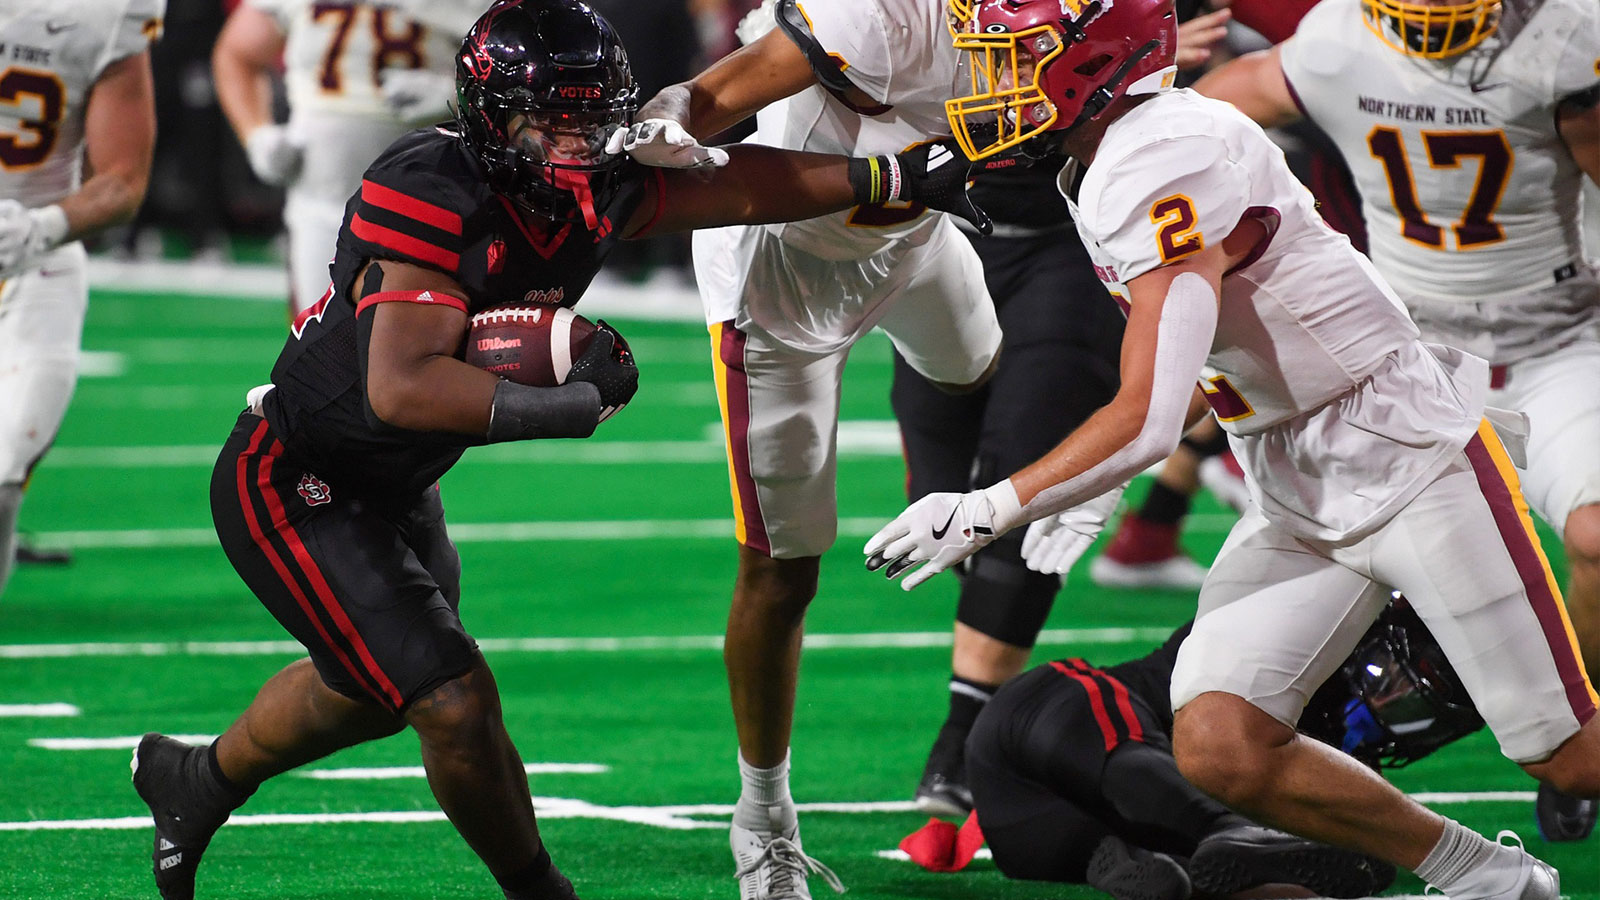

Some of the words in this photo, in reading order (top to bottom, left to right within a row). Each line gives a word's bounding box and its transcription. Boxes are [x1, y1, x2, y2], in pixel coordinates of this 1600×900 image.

[310, 1, 425, 98] 78
[559, 86, 601, 98] YOTES
[1358, 94, 1436, 122] NORTHERN
[1445, 106, 1492, 126] STATE
[892, 161, 901, 179] TEAM
[985, 158, 1016, 169] ADIZERO
[892, 179, 901, 199] FIRST
[1366, 124, 1515, 252] 17
[1148, 193, 1205, 265] 2
[477, 336, 522, 351] Wilson
